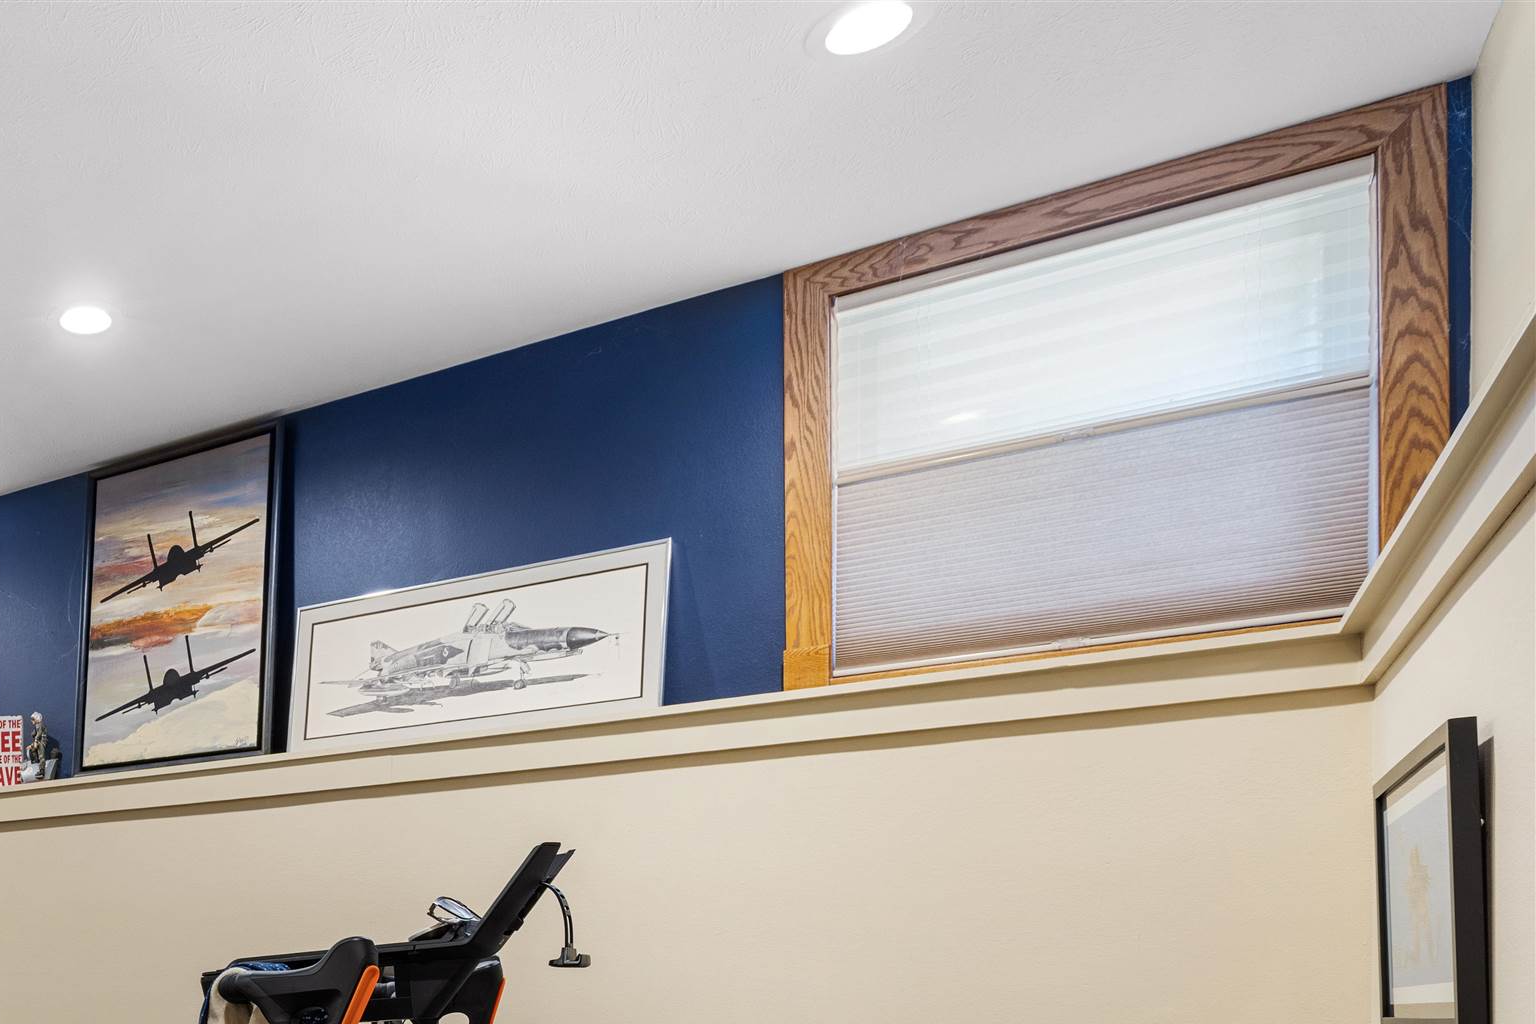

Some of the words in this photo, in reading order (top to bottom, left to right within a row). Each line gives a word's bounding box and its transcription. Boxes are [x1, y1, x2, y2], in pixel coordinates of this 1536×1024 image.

[8, 719, 21, 728] THE
[3, 754, 11, 764] OF
[11, 754, 22, 764] THE
